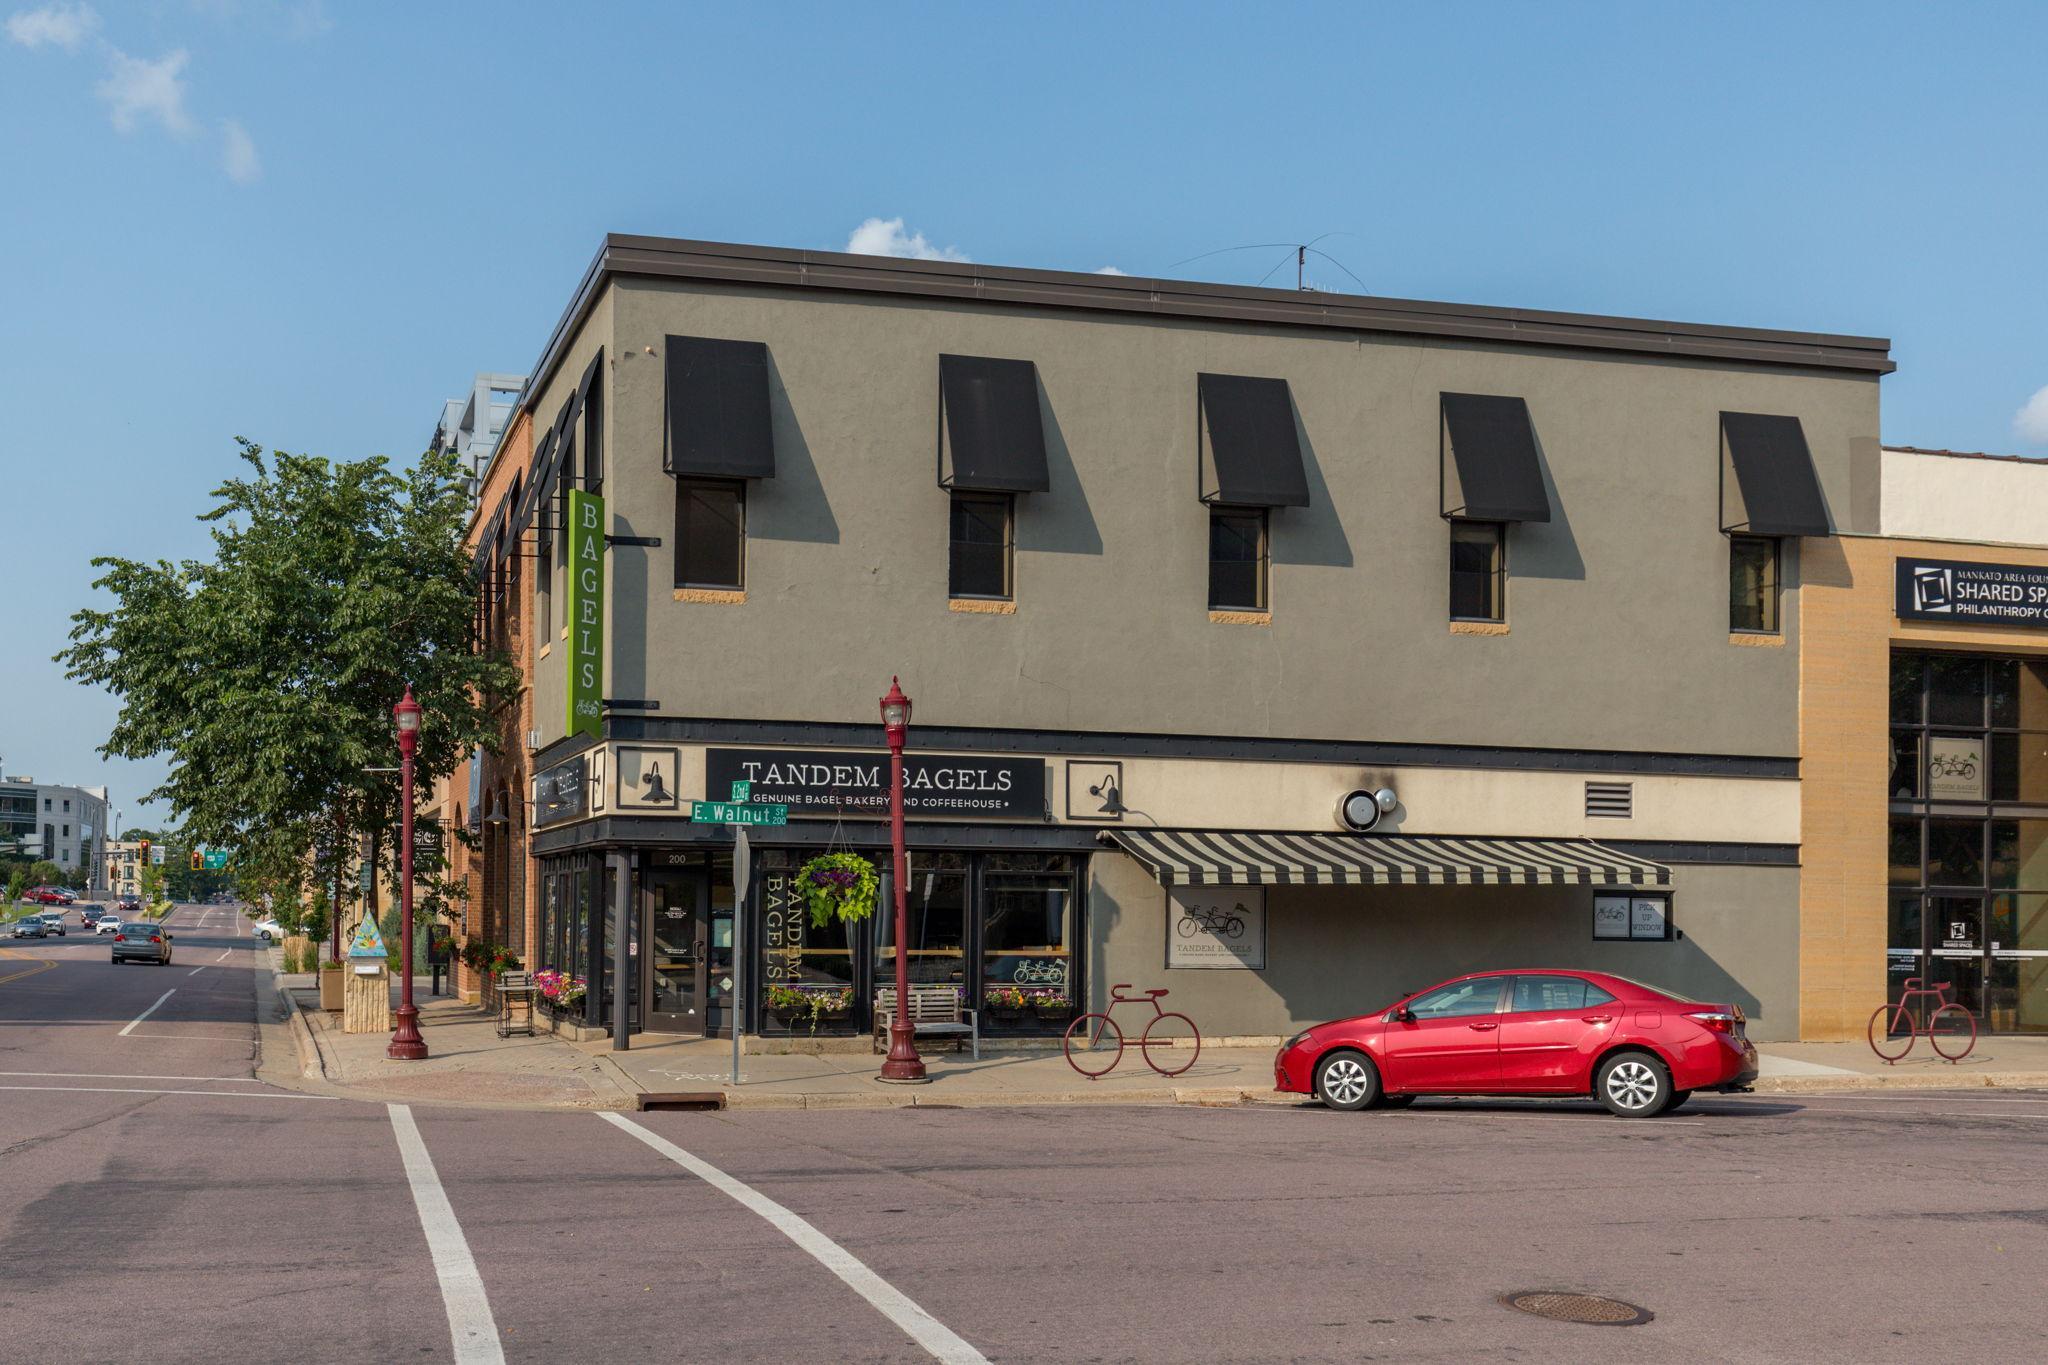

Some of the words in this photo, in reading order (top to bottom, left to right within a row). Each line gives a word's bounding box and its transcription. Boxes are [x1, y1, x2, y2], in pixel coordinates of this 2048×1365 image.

[1957, 571, 2002, 581] MANKATO
[2003, 573, 2026, 583] AREA
[581, 502, 598, 689] BAGELS
[1956, 582, 2023, 602] SHARED
[1956, 603, 2042, 618] PHILANTHROPY
[742, 761, 880, 788] TANDEM
[753, 793, 802, 804] GENUINE
[805, 795, 842, 805] BAGEL
[845, 796, 891, 806] BAKERY
[903, 797, 919, 807] ND
[922, 798, 1002, 809] COFFEEHOUSE
[694, 804, 708, 820] E.
[713, 804, 770, 822] Walnut
[775, 807, 784, 816] St
[772, 817, 787, 825] 200
[668, 854, 686, 864] 200
[1638, 903, 1656, 911] PICK
[1641, 913, 1653, 921] UP
[766, 876, 783, 979] BAGELS
[1176, 944, 1215, 952] TANDEM
[1218, 944, 1253, 953] BAGELS
